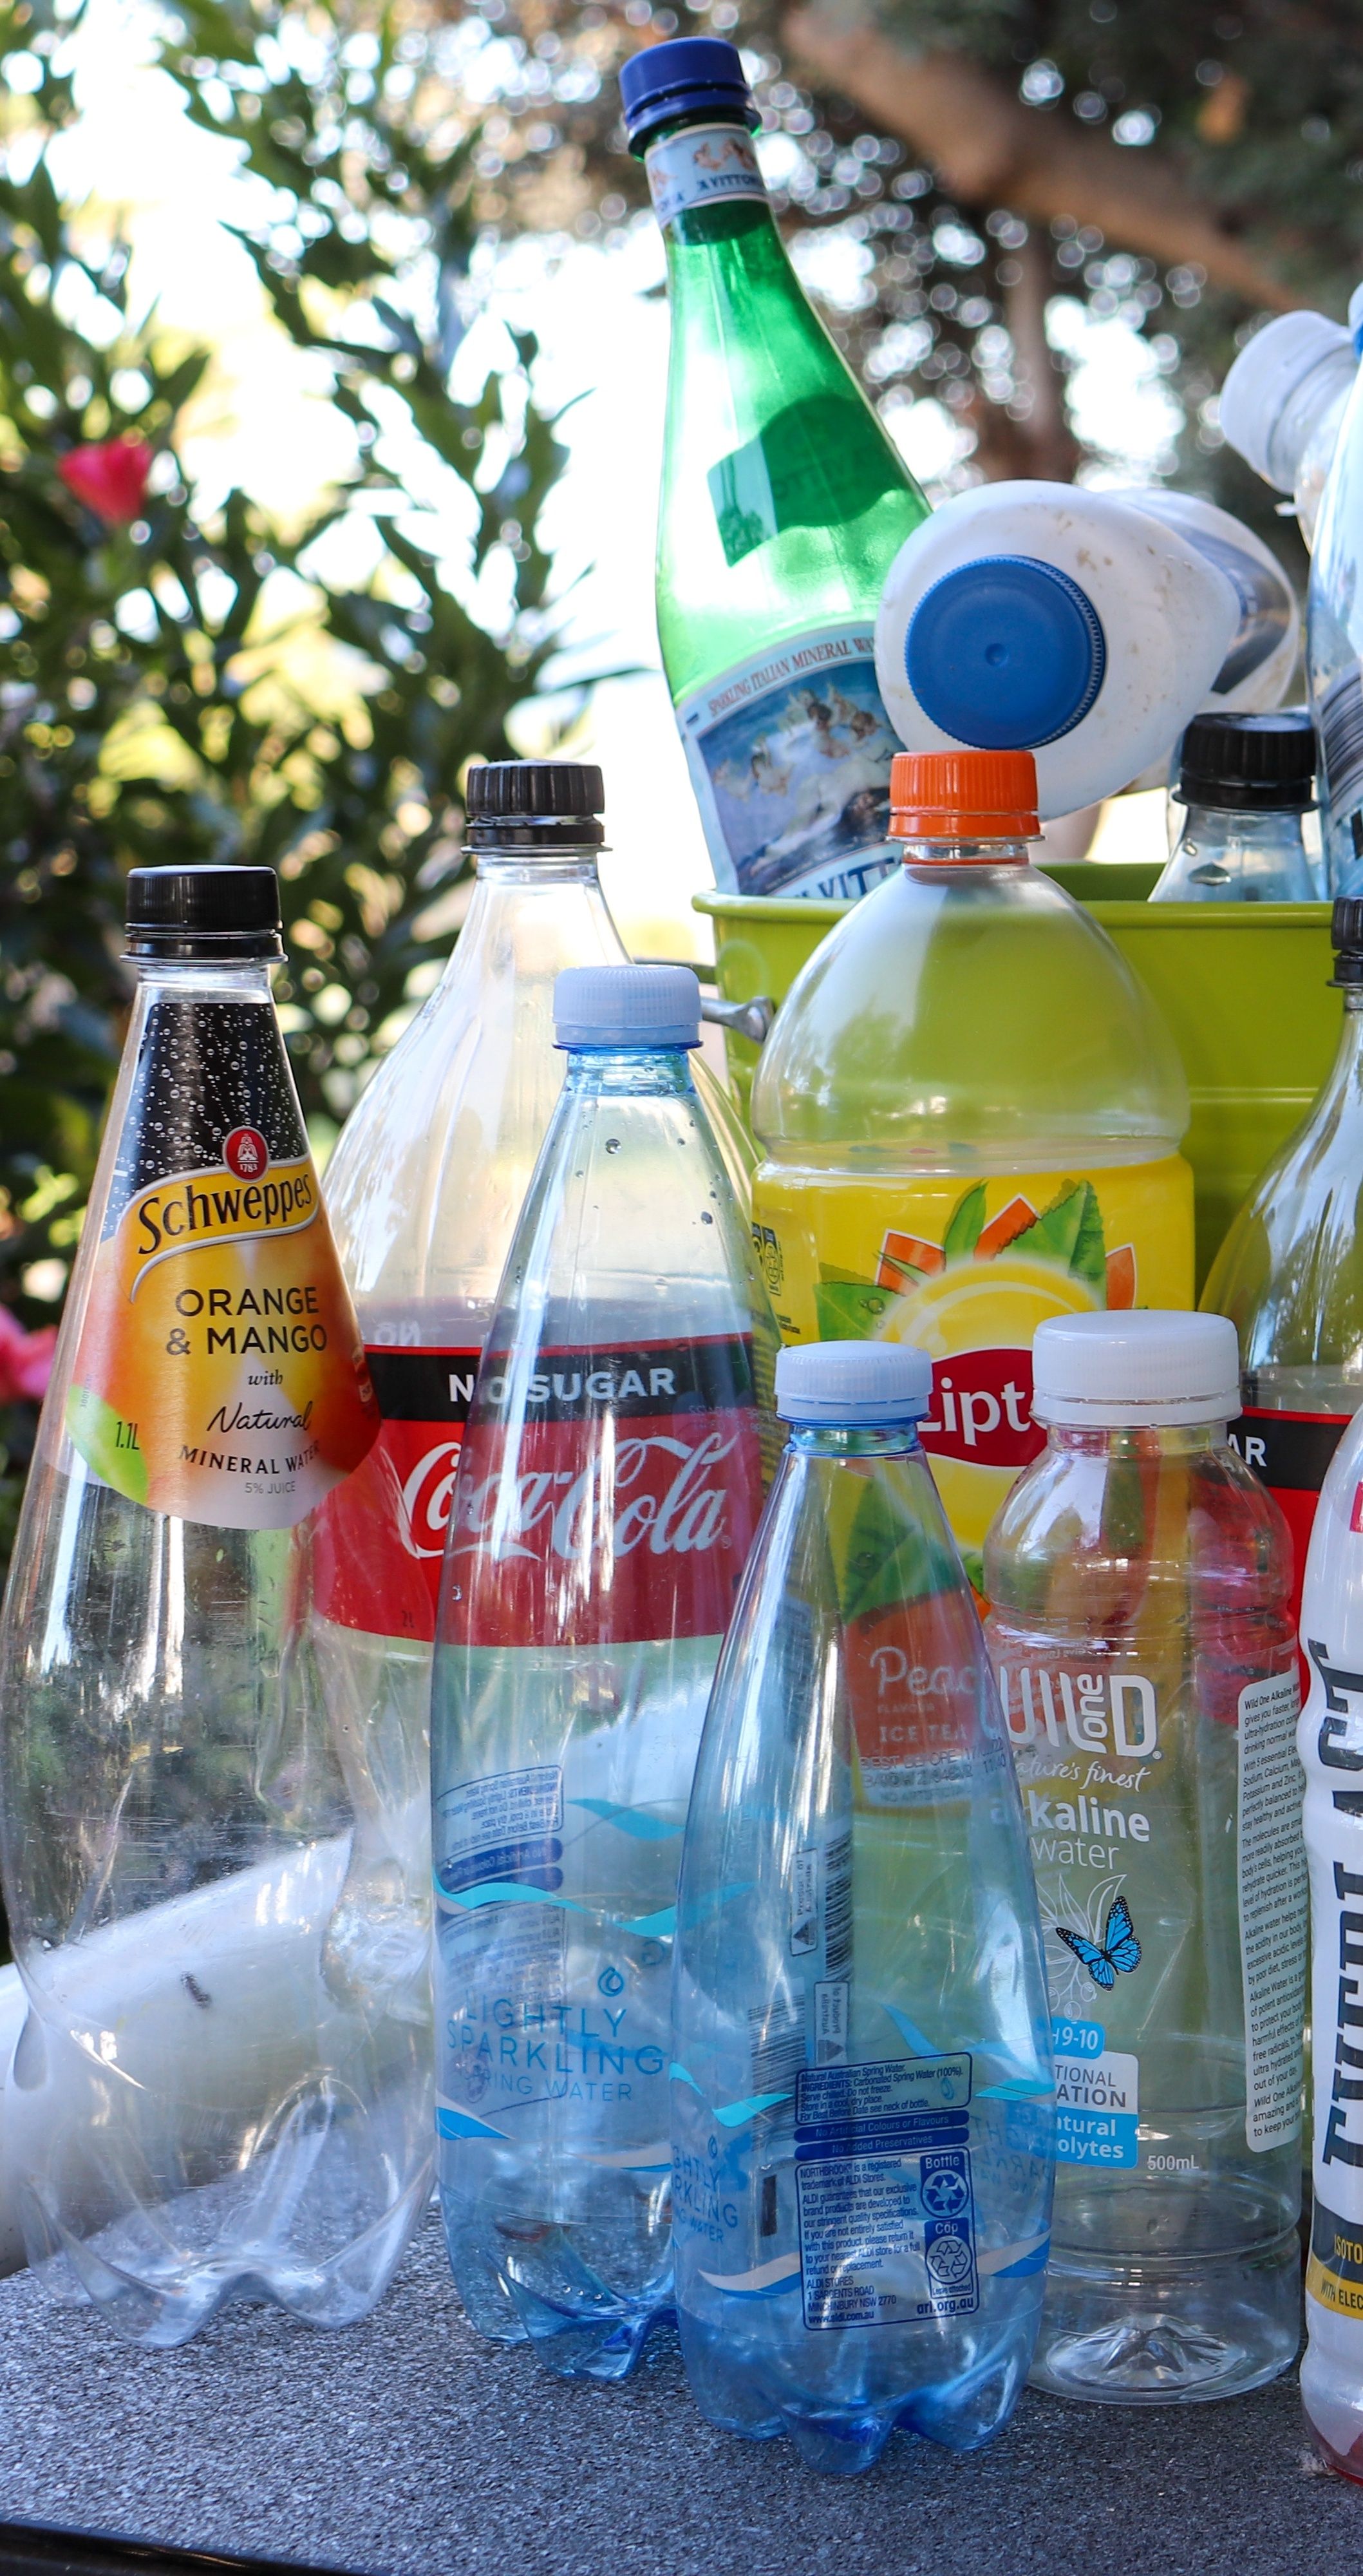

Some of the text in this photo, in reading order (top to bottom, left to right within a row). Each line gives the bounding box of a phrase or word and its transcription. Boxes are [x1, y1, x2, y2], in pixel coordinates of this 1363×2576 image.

[751, 657, 791, 691] ITALIAN
[791, 639, 851, 668] MINERAL
[238, 1162, 259, 1173] 1783
[137, 1172, 314, 1255] Schweppes
[175, 1286, 319, 1317] ORANGE
[165, 1323, 327, 1356] & MANGO
[247, 1369, 283, 1387] with
[449, 1367, 676, 1404] NO SUGAR
[206, 1400, 314, 1434] Natural
[916, 1376, 1048, 1447] ipt
[115, 1419, 140, 1450] 1.1L
[179, 1443, 321, 1475] MINERAL WATER
[245, 1481, 296, 1494] 5% JUICE
[402, 1432, 738, 1562] Coca-Cola
[869, 1644, 979, 1697] Peac
[1076, 1673, 1108, 1739] one
[1245, 1687, 1292, 1710] Wild One Alkaline
[1245, 1709, 1272, 1728] gives you
[879, 1723, 966, 1743] ICE TEA
[1244, 1730, 1287, 1755] drinking normal
[1261, 1747, 1287, 1765] essential
[1016, 1754, 1151, 1793] ature's finest
[1243, 1776, 1283, 1802] Potassium and
[1264, 1786, 1292, 1807] balanced
[1022, 1789, 1151, 1843] kaline
[1274, 1804, 1285, 1817] and
[1241, 1822, 1290, 1849] The molecules are
[1031, 1836, 1120, 1870] water
[1241, 1851, 1255, 1864] more
[1274, 1830, 1300, 1850] absorbed
[1273, 1849, 1294, 1865] helping
[1260, 1881, 1287, 1900] hydration
[1264, 1917, 1281, 1931] water
[1270, 1978, 1288, 1992] Water
[465, 1988, 627, 2039] LIGHTLY
[1258, 1998, 1275, 2017] potent
[1259, 2012, 1279, 2031] protect
[447, 2017, 664, 2076] SPARKLING
[1252, 2028, 1277, 2047] harmful
[1252, 2050, 1267, 2061] free
[1253, 2050, 1293, 2076] ultra hydrated
[853, 2074, 892, 2087] Carbonated
[892, 2071, 915, 2083] Spring
[915, 2069, 936, 2079] Water
[863, 2065, 885, 2079] Spring
[1054, 2064, 1117, 2088] TIONAL
[1254, 2070, 1288, 2090] out of your
[545, 2076, 632, 2103] WATER
[847, 2087, 857, 2097] Do
[1057, 2084, 1127, 2108] ATION
[1254, 2090, 1285, 2108] Wild One
[852, 2101, 900, 2116] Date neck
[1252, 2105, 1284, 2123] amazing
[868, 2121, 901, 2132] Colours
[913, 2116, 950, 2126] Flavours
[1057, 2115, 1116, 2137] tural
[1254, 2121, 1282, 2137] to keep
[875, 2136, 933, 2149] Preservatives
[1058, 2138, 1124, 2160] olytes
[925, 2155, 960, 2170] Bottle
[1147, 2154, 1200, 2171] 500mL
[673, 2155, 722, 2193] GHTLY
[845, 2174, 861, 2185] ALDI
[672, 2174, 739, 2230] RKLING
[802, 2193, 819, 2204] ALDI
[885, 2182, 917, 2195] exclusive
[803, 2195, 902, 2217] brand developed
[935, 2222, 959, 2235] Cap
[1333, 2233, 1363, 2266] ISOTO
[806, 2275, 854, 2289] ALDI STORES
[814, 2285, 875, 2301] SARGENTS ROAD
[860, 2295, 898, 2308] NSW 2770
[1320, 2277, 1363, 2311] WITH ELEC
[916, 2297, 973, 2315] arl.org.au
